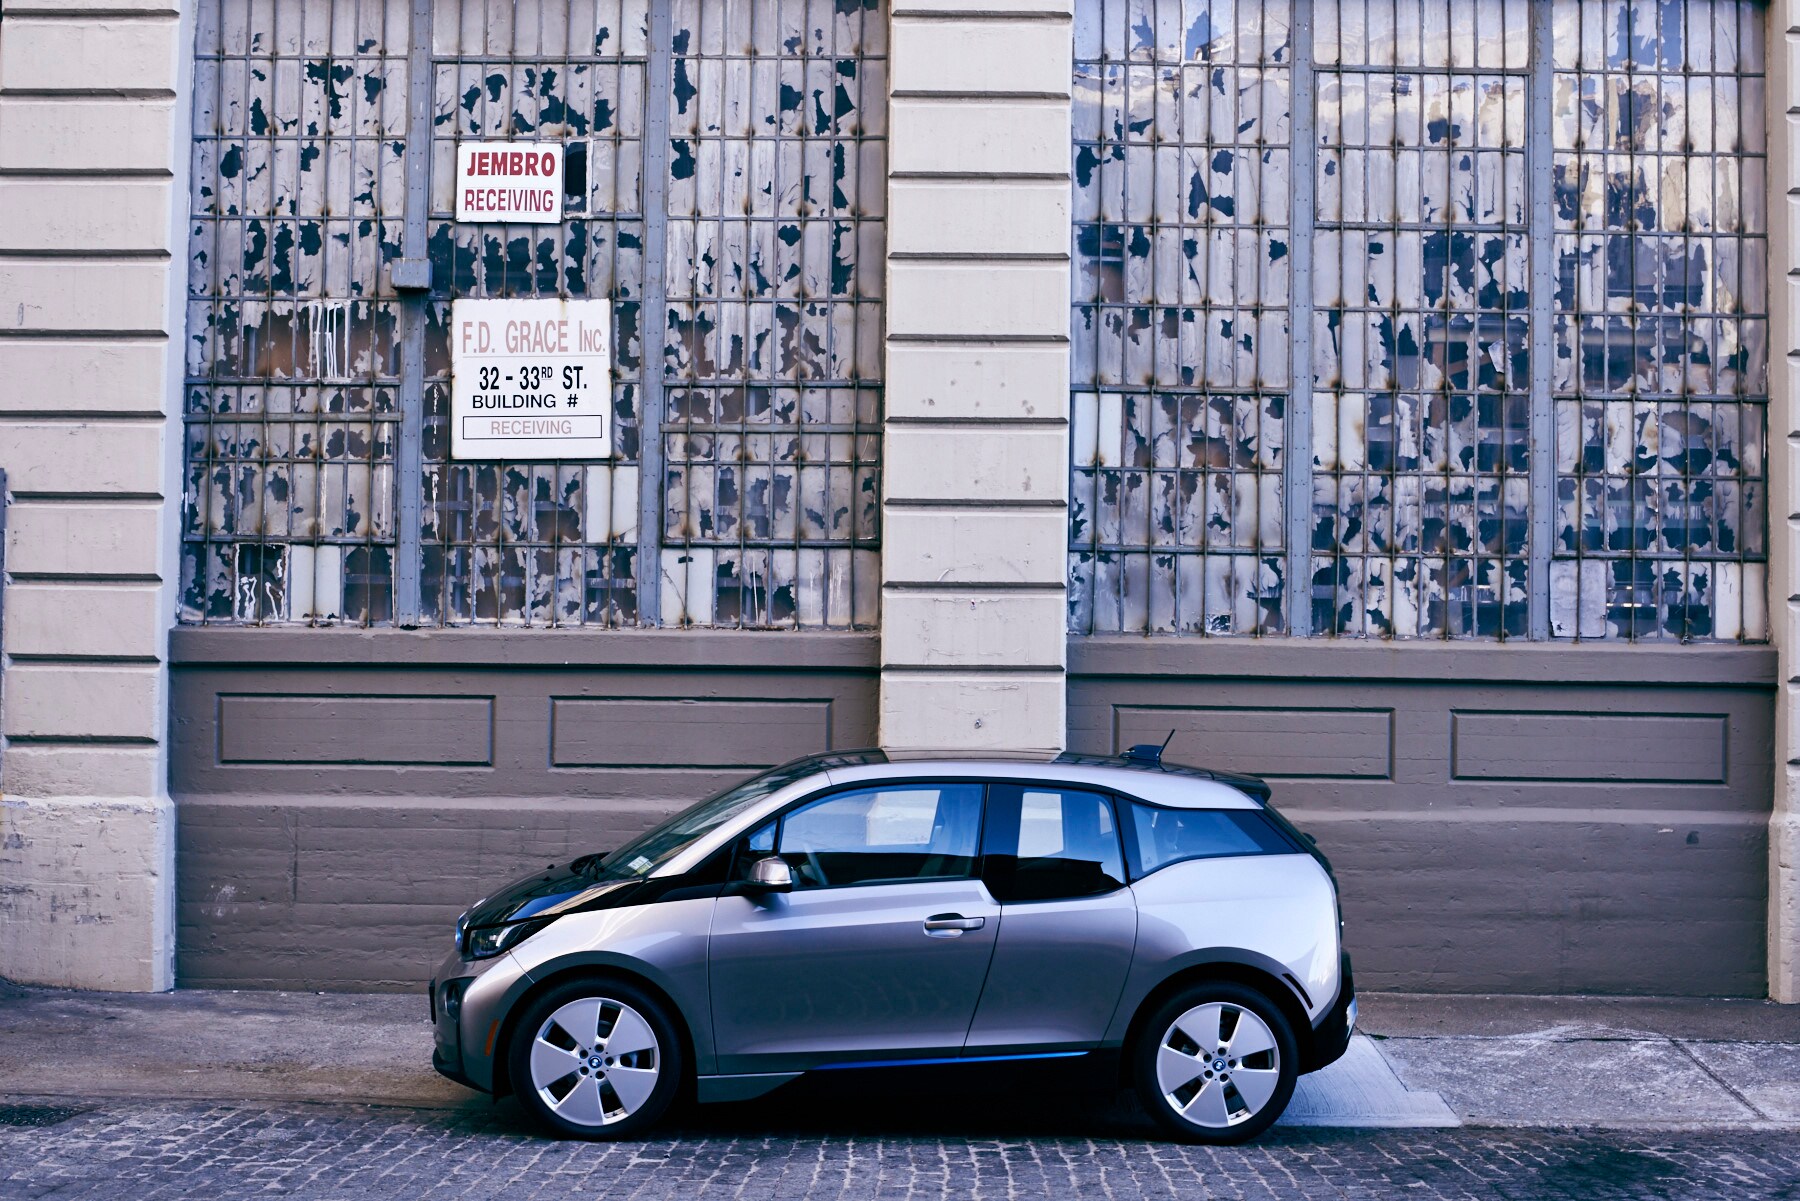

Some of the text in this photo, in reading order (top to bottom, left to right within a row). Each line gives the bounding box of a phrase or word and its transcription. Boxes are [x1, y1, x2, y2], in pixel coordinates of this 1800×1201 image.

[467, 151, 556, 177] JEMBRO
[465, 188, 554, 212] RECEIVING
[462, 321, 495, 354] F.D.
[506, 319, 569, 353] GRACE
[479, 366, 500, 390] 32
[562, 365, 588, 390] ST.
[472, 394, 579, 409] BUILDING #
[491, 419, 572, 435] RECEIVING
